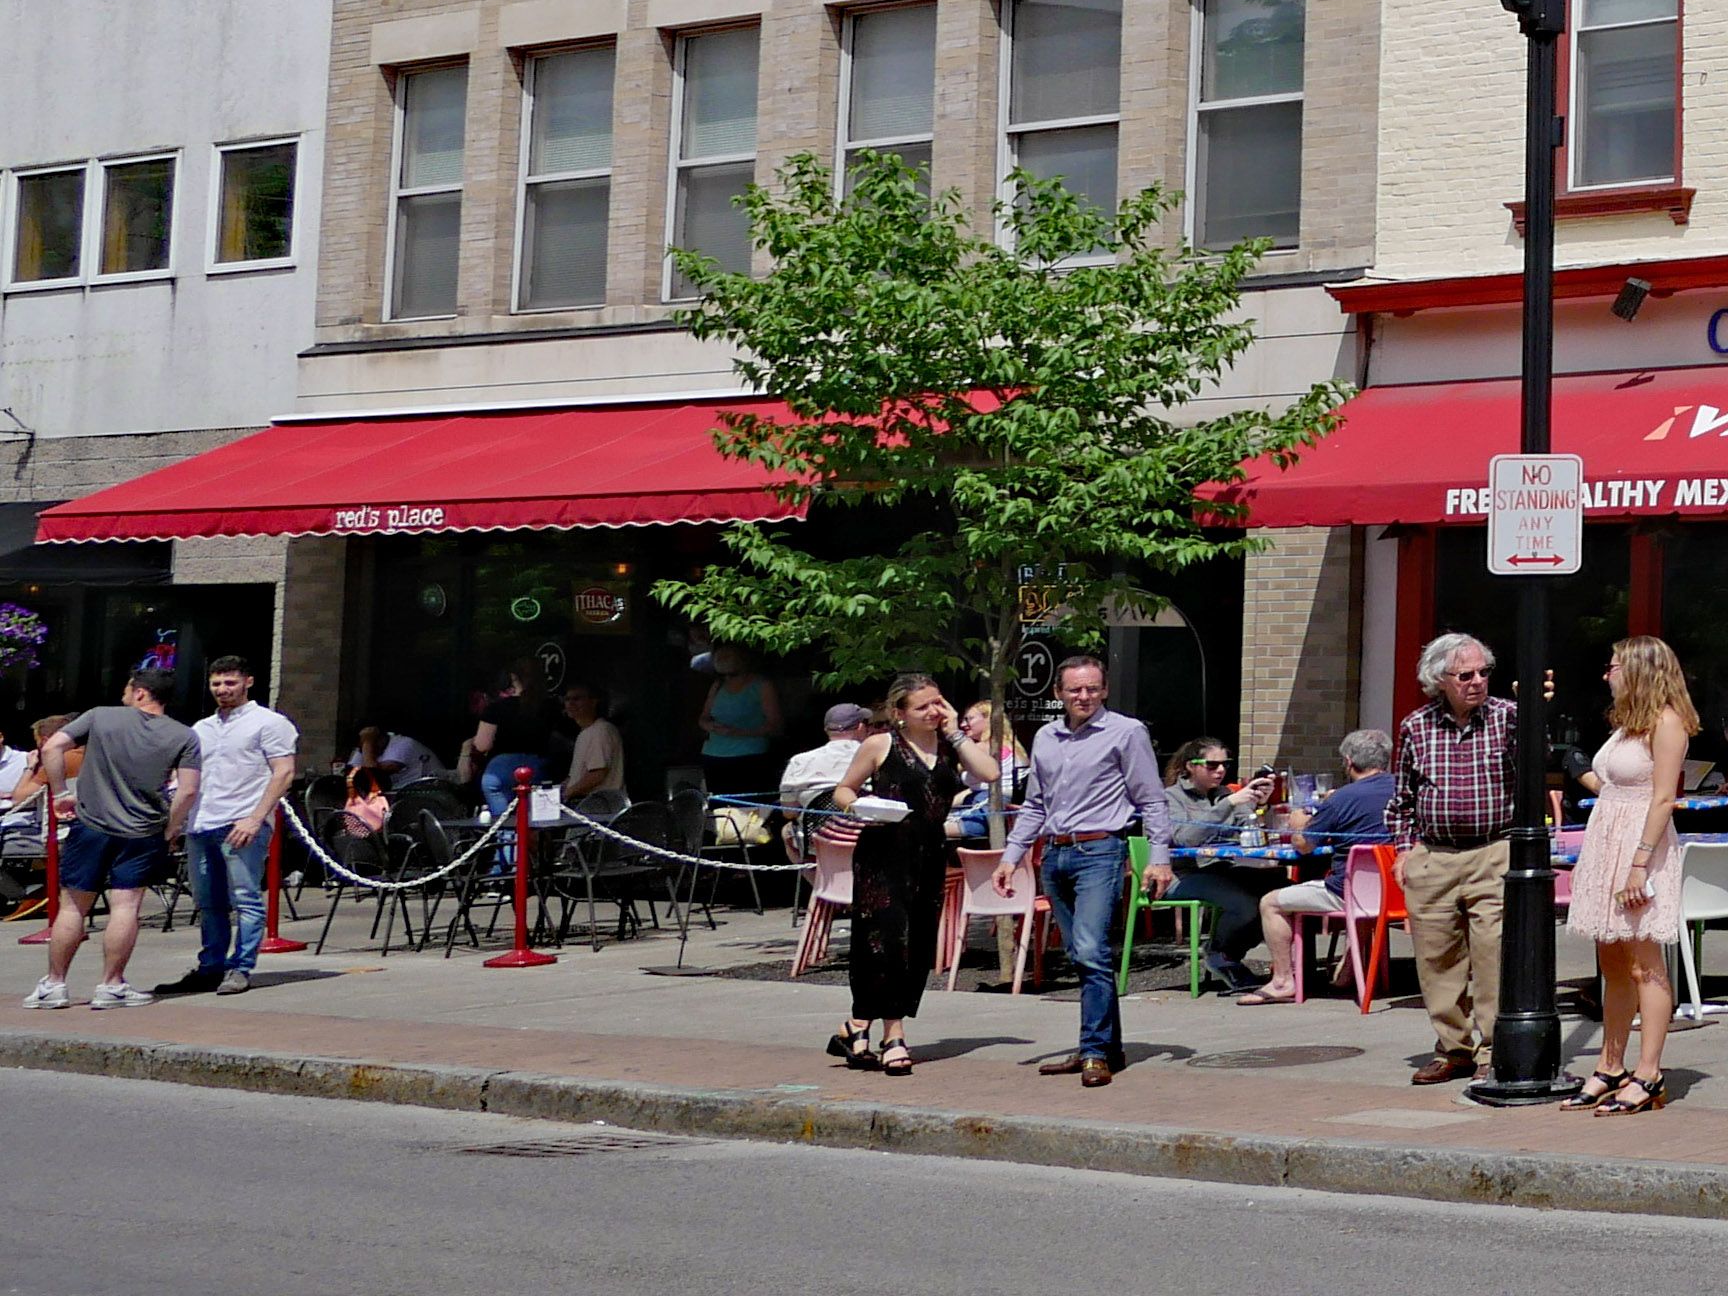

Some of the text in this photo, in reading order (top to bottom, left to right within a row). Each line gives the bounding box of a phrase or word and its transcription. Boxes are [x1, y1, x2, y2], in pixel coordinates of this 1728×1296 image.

[1521, 464, 1552, 486] NO
[1445, 487, 1490, 516] FRE
[1580, 479, 1666, 509] ALTHY
[1496, 488, 1576, 511] STANDING
[334, 504, 444, 534] red's place
[1518, 515, 1554, 531] ANY
[1515, 535, 1555, 551] TIME
[1020, 652, 1047, 685] r
